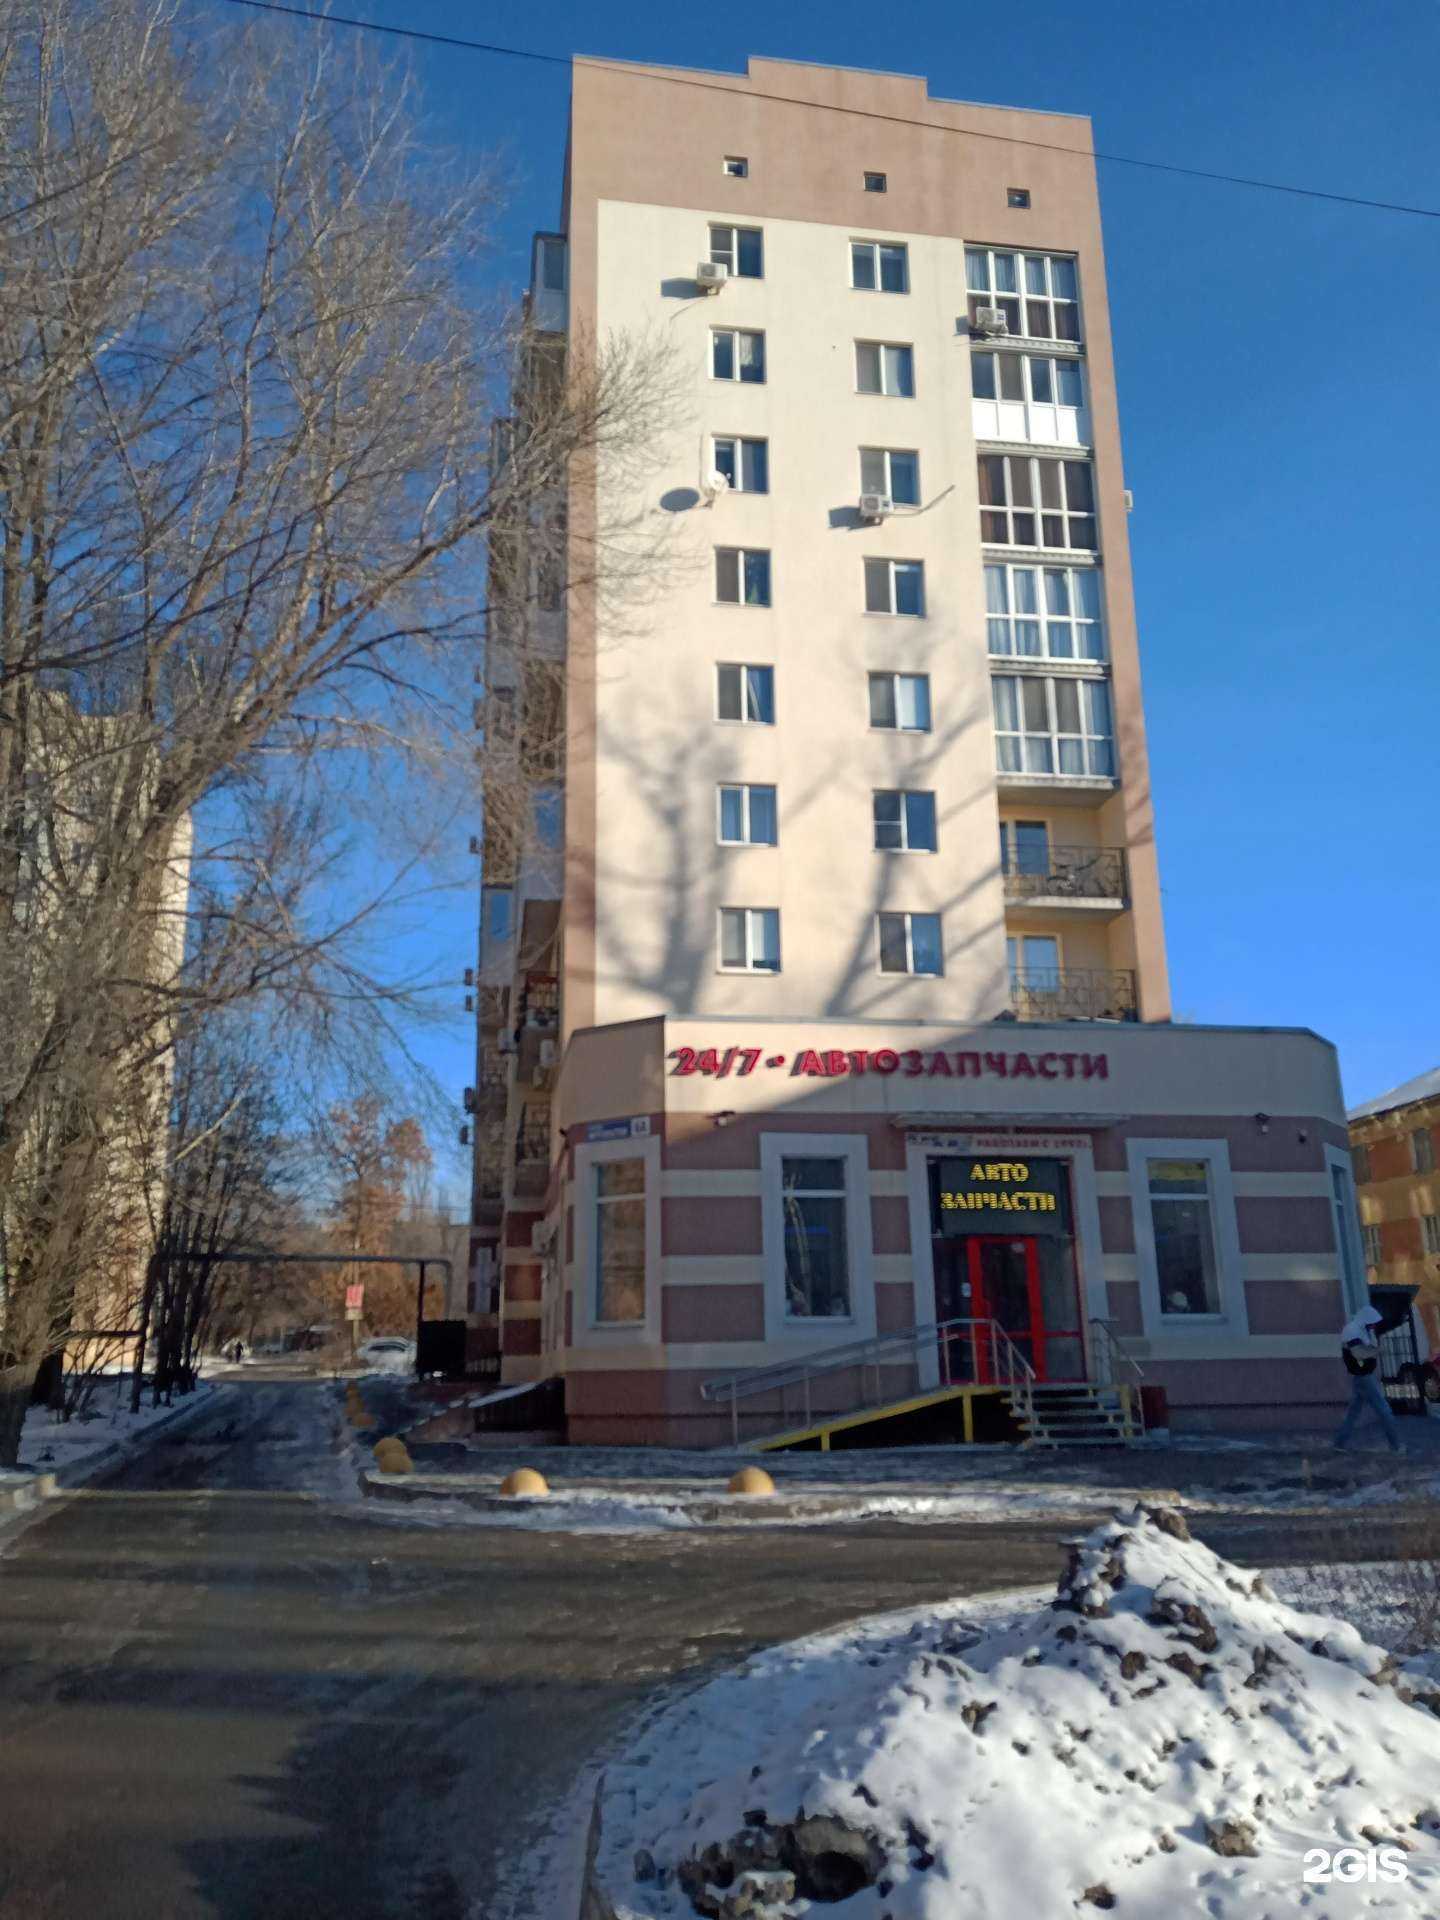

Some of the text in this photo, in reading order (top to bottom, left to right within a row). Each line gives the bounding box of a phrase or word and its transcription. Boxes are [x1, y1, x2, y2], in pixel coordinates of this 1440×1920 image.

[674, 1047, 1108, 1079] 24/7 АВТОЗАПЧАСТИ
[970, 1162, 1029, 1182] АВТО
[941, 1191, 1056, 1212] ЗАПЧАСТИ
